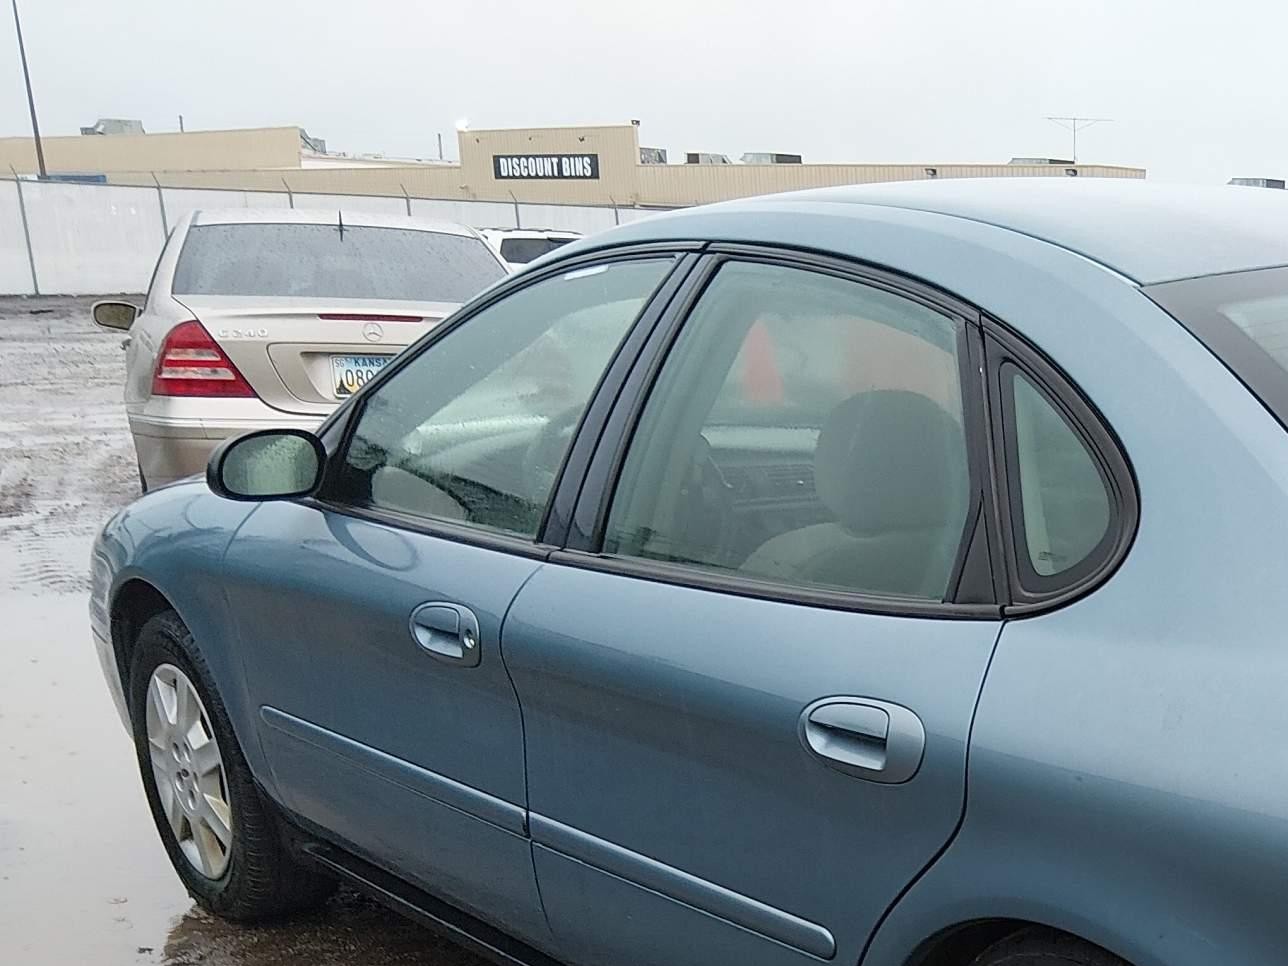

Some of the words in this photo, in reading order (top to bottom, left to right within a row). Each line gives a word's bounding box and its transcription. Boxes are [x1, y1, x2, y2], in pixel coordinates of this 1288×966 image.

[500, 157, 558, 177] DISCOUNT
[562, 156, 592, 177] BINS
[354, 357, 391, 367] KANSA
